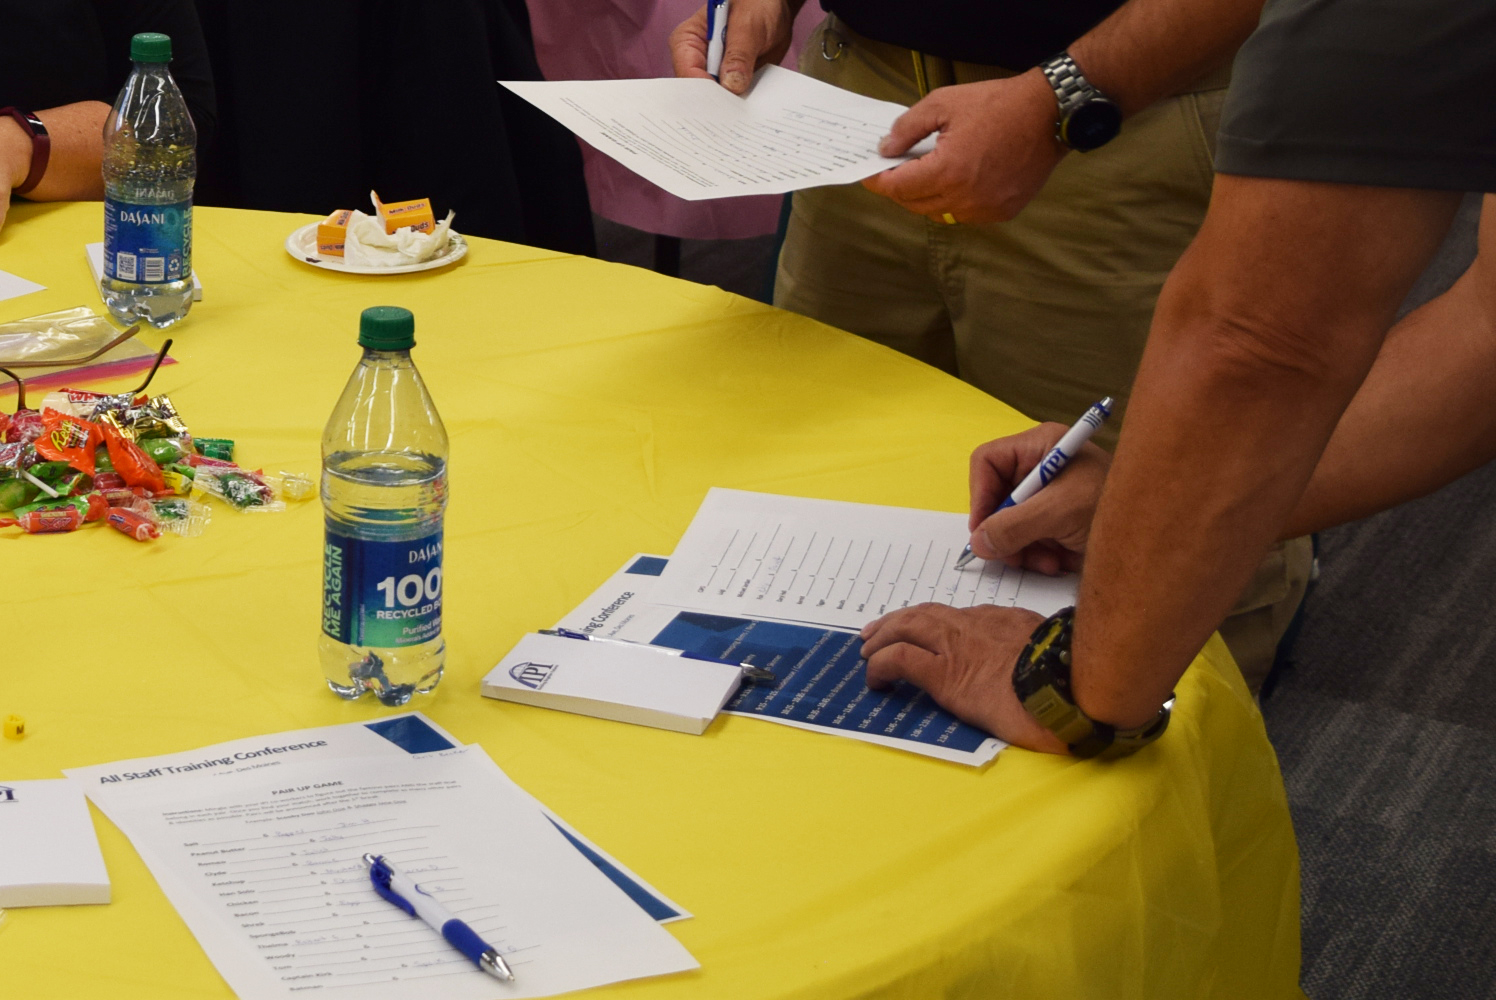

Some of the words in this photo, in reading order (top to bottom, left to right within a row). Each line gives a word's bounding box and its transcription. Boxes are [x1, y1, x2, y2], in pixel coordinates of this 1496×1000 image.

[120, 210, 165, 226] DASANI
[410, 222, 431, 233] Duds
[1044, 448, 1069, 478] IPI
[409, 542, 442, 563] DASAN
[331, 545, 343, 606] AGAIN
[377, 566, 442, 609] 100
[376, 604, 433, 620] RECYCLED
[598, 590, 635, 625] Conference
[402, 621, 433, 635] Purified
[524, 662, 554, 683] IPI
[100, 775, 122, 785] All
[122, 767, 163, 781] Staff
[163, 754, 235, 775] Training
[234, 739, 328, 761] Conference
[271, 787, 295, 796] PAIR
[297, 784, 312, 792] UP
[313, 780, 345, 789] GAME
